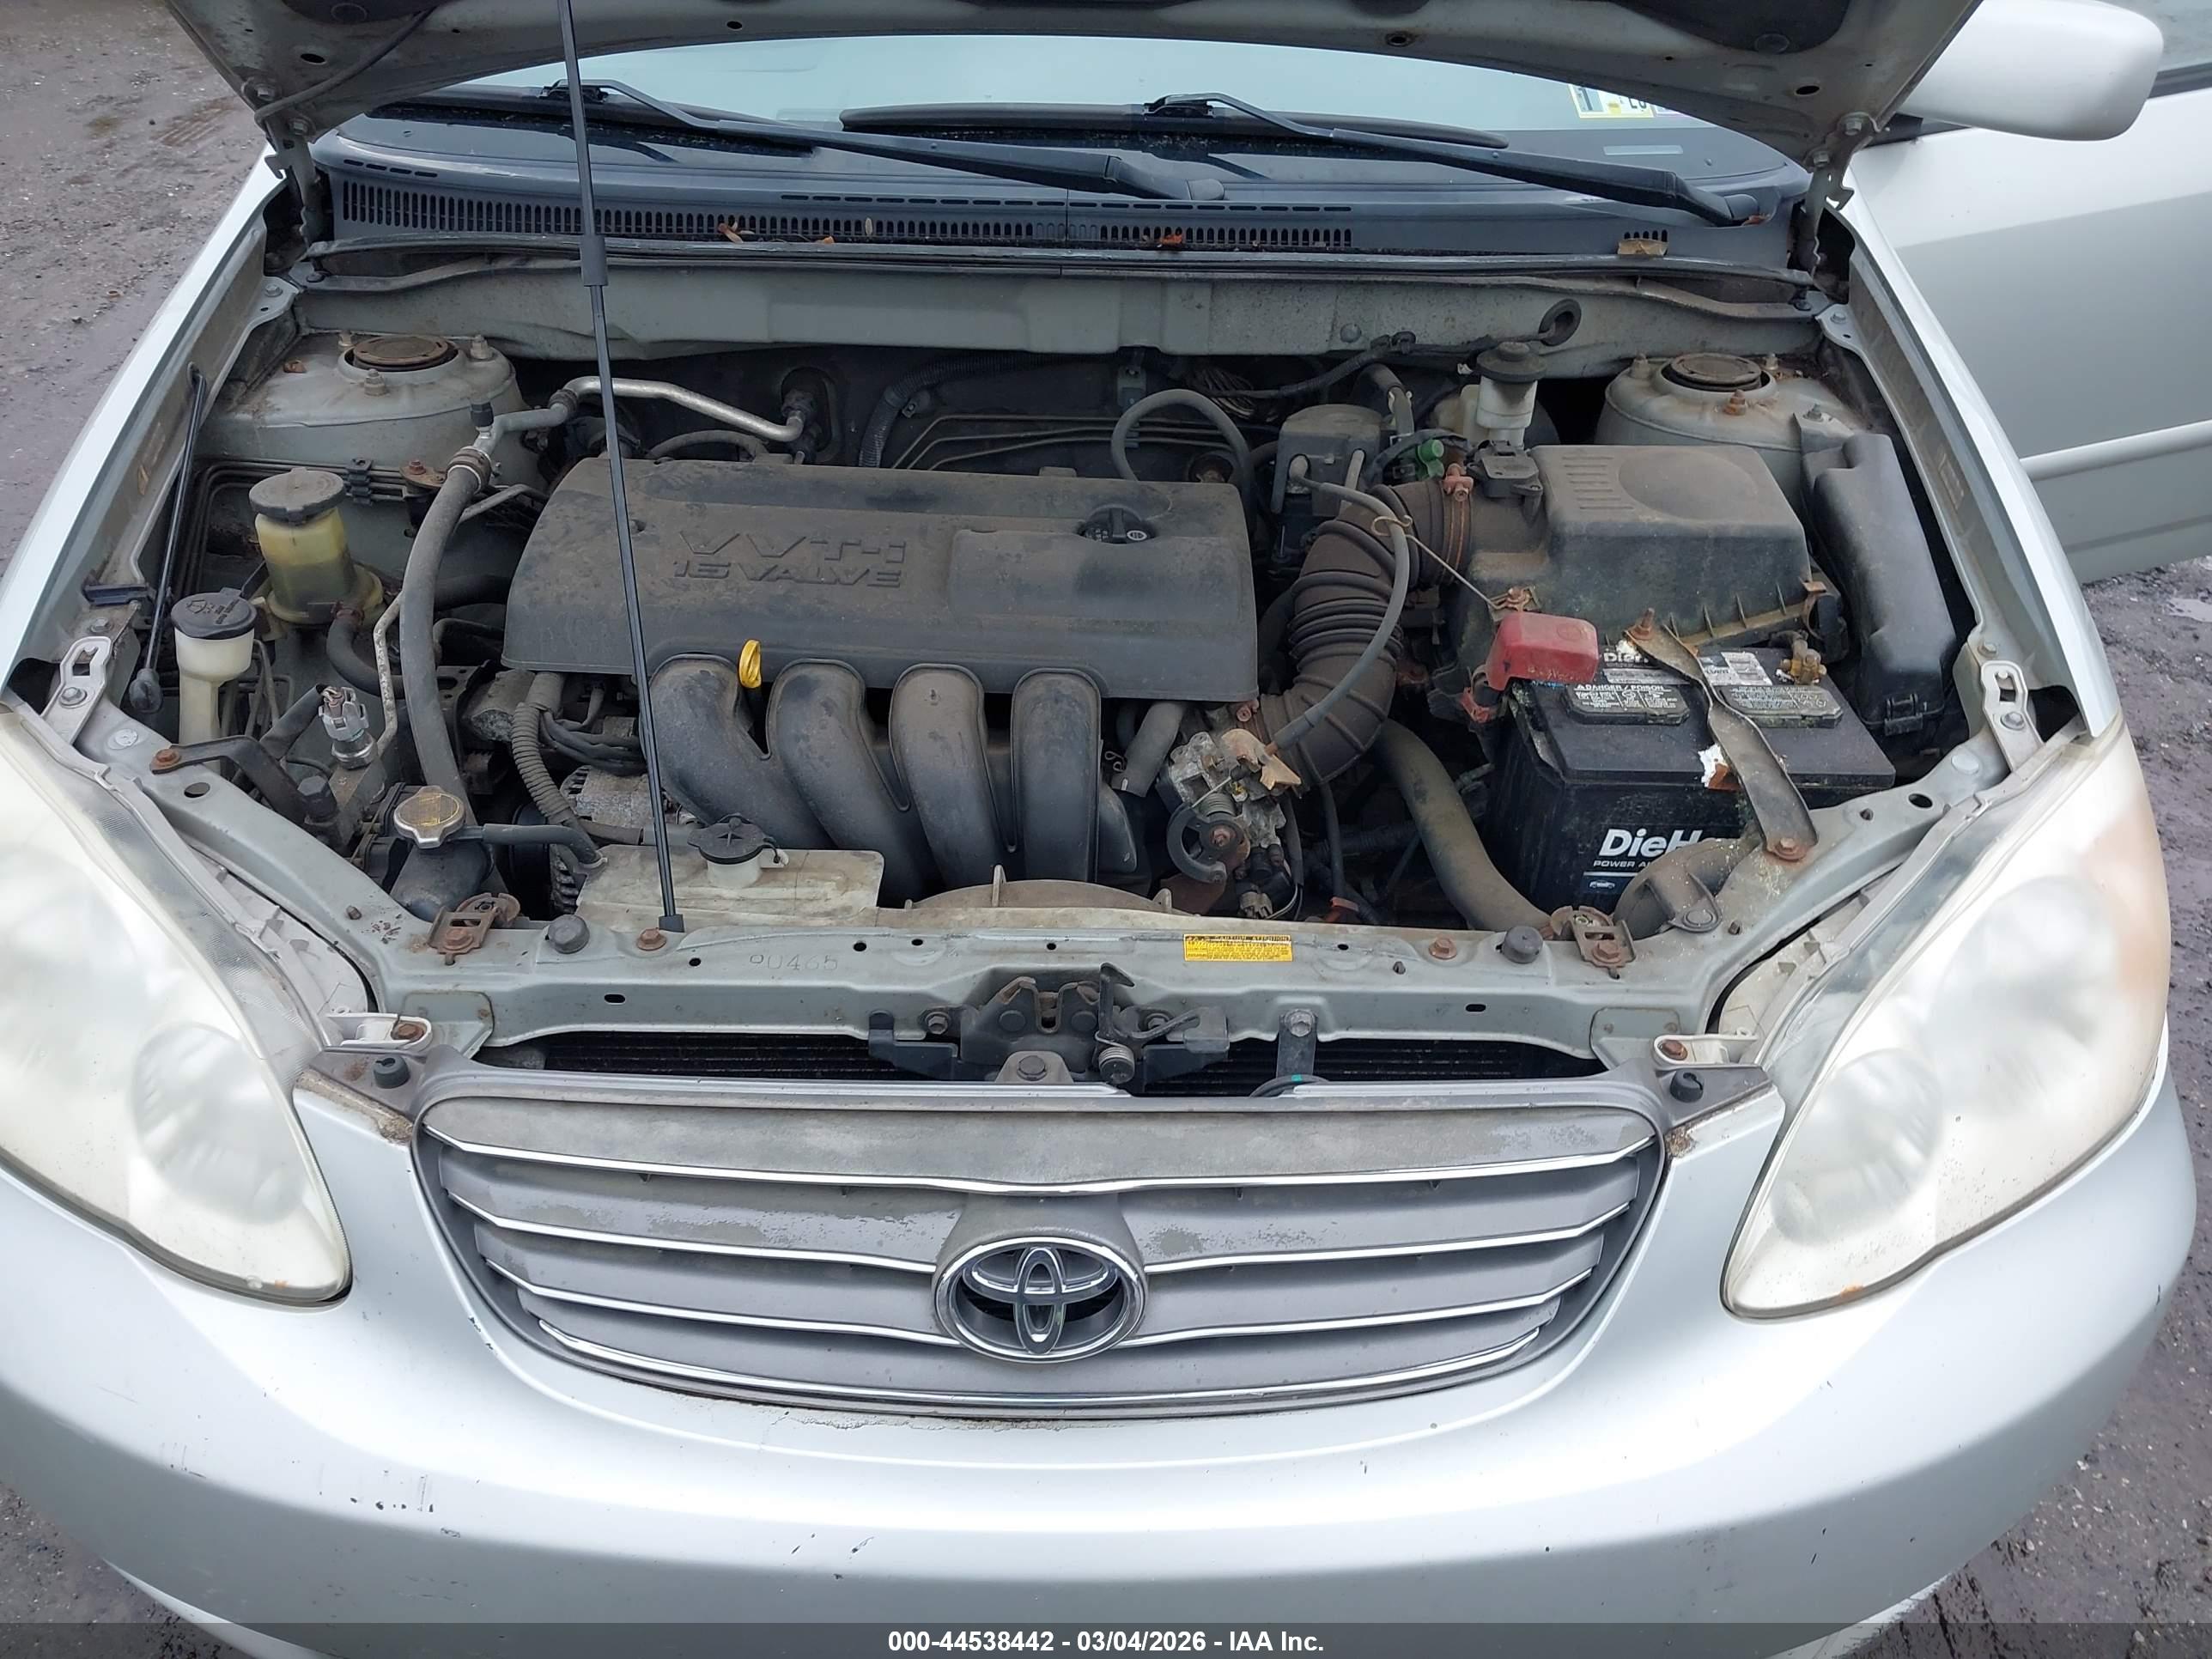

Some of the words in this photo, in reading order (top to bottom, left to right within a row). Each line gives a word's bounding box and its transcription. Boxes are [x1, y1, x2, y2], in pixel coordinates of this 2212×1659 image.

[672, 560, 732, 579] 16
[737, 563, 902, 588] VALVE
[1599, 828, 1703, 857] DieH
